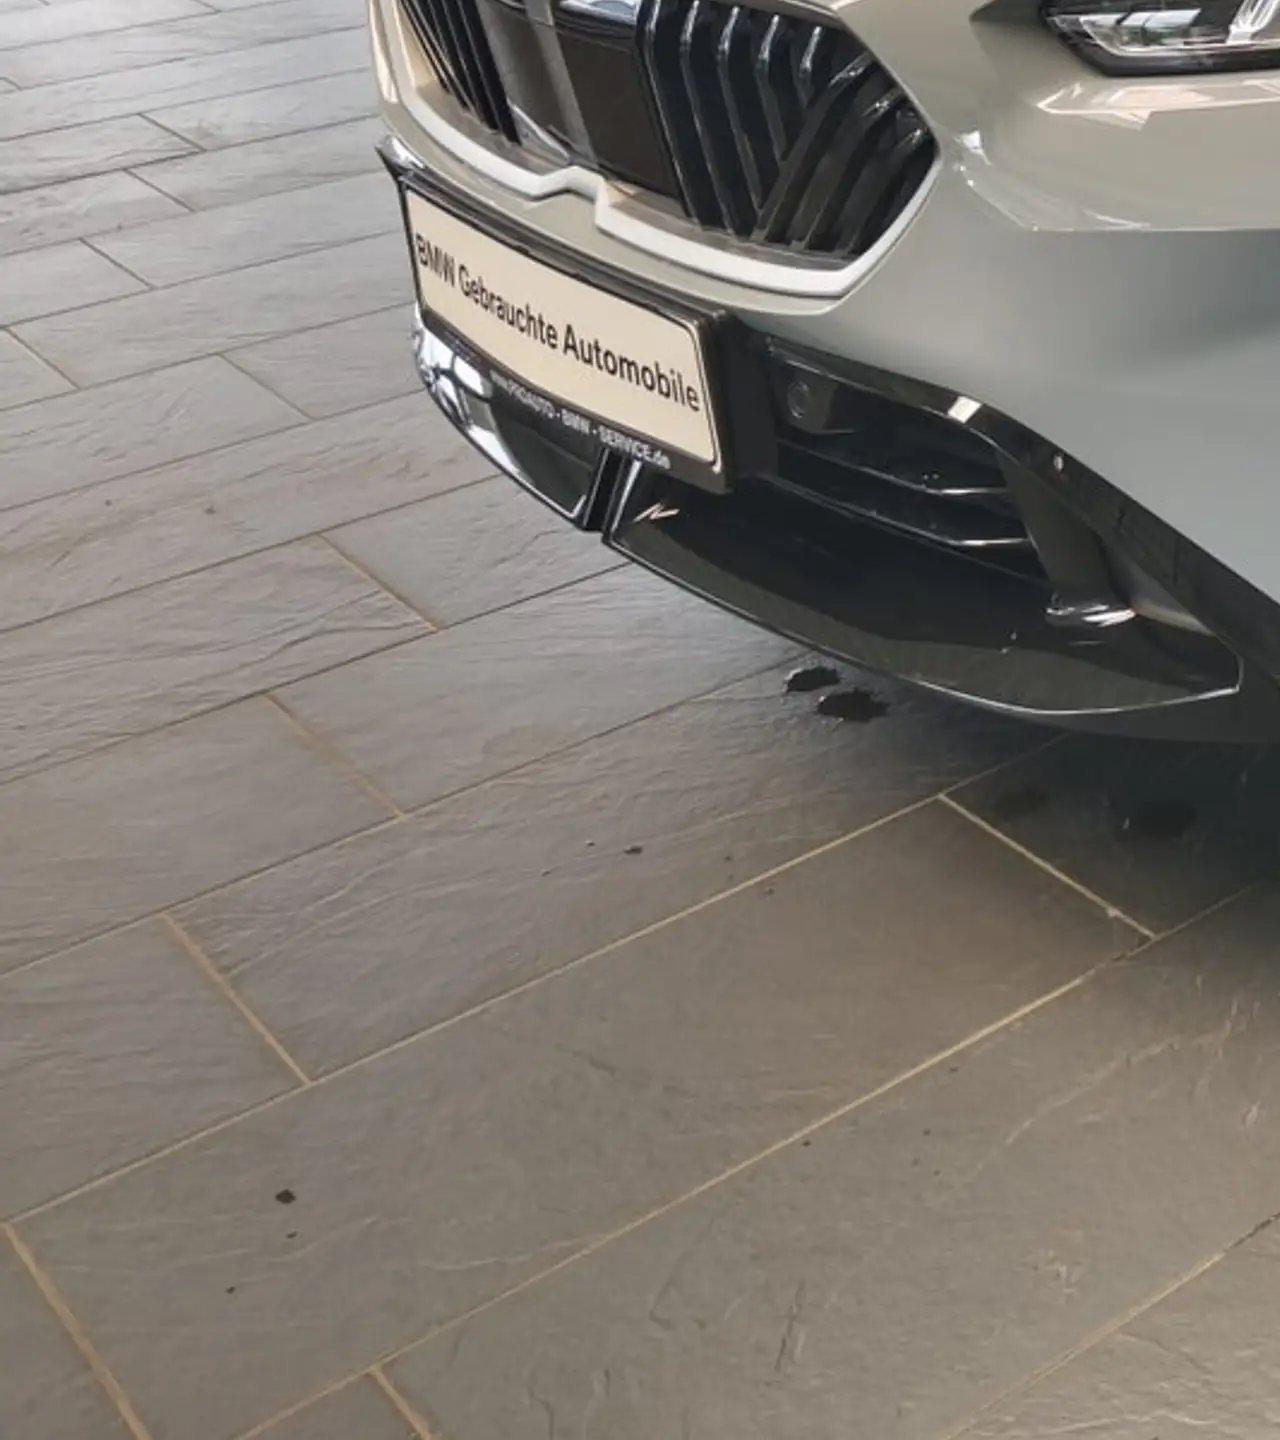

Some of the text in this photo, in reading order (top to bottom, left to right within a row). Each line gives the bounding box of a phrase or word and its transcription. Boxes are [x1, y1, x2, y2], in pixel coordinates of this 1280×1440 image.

[415, 231, 456, 288] BMW
[458, 263, 558, 350] Gebrauchte
[563, 323, 701, 412] Automobile
